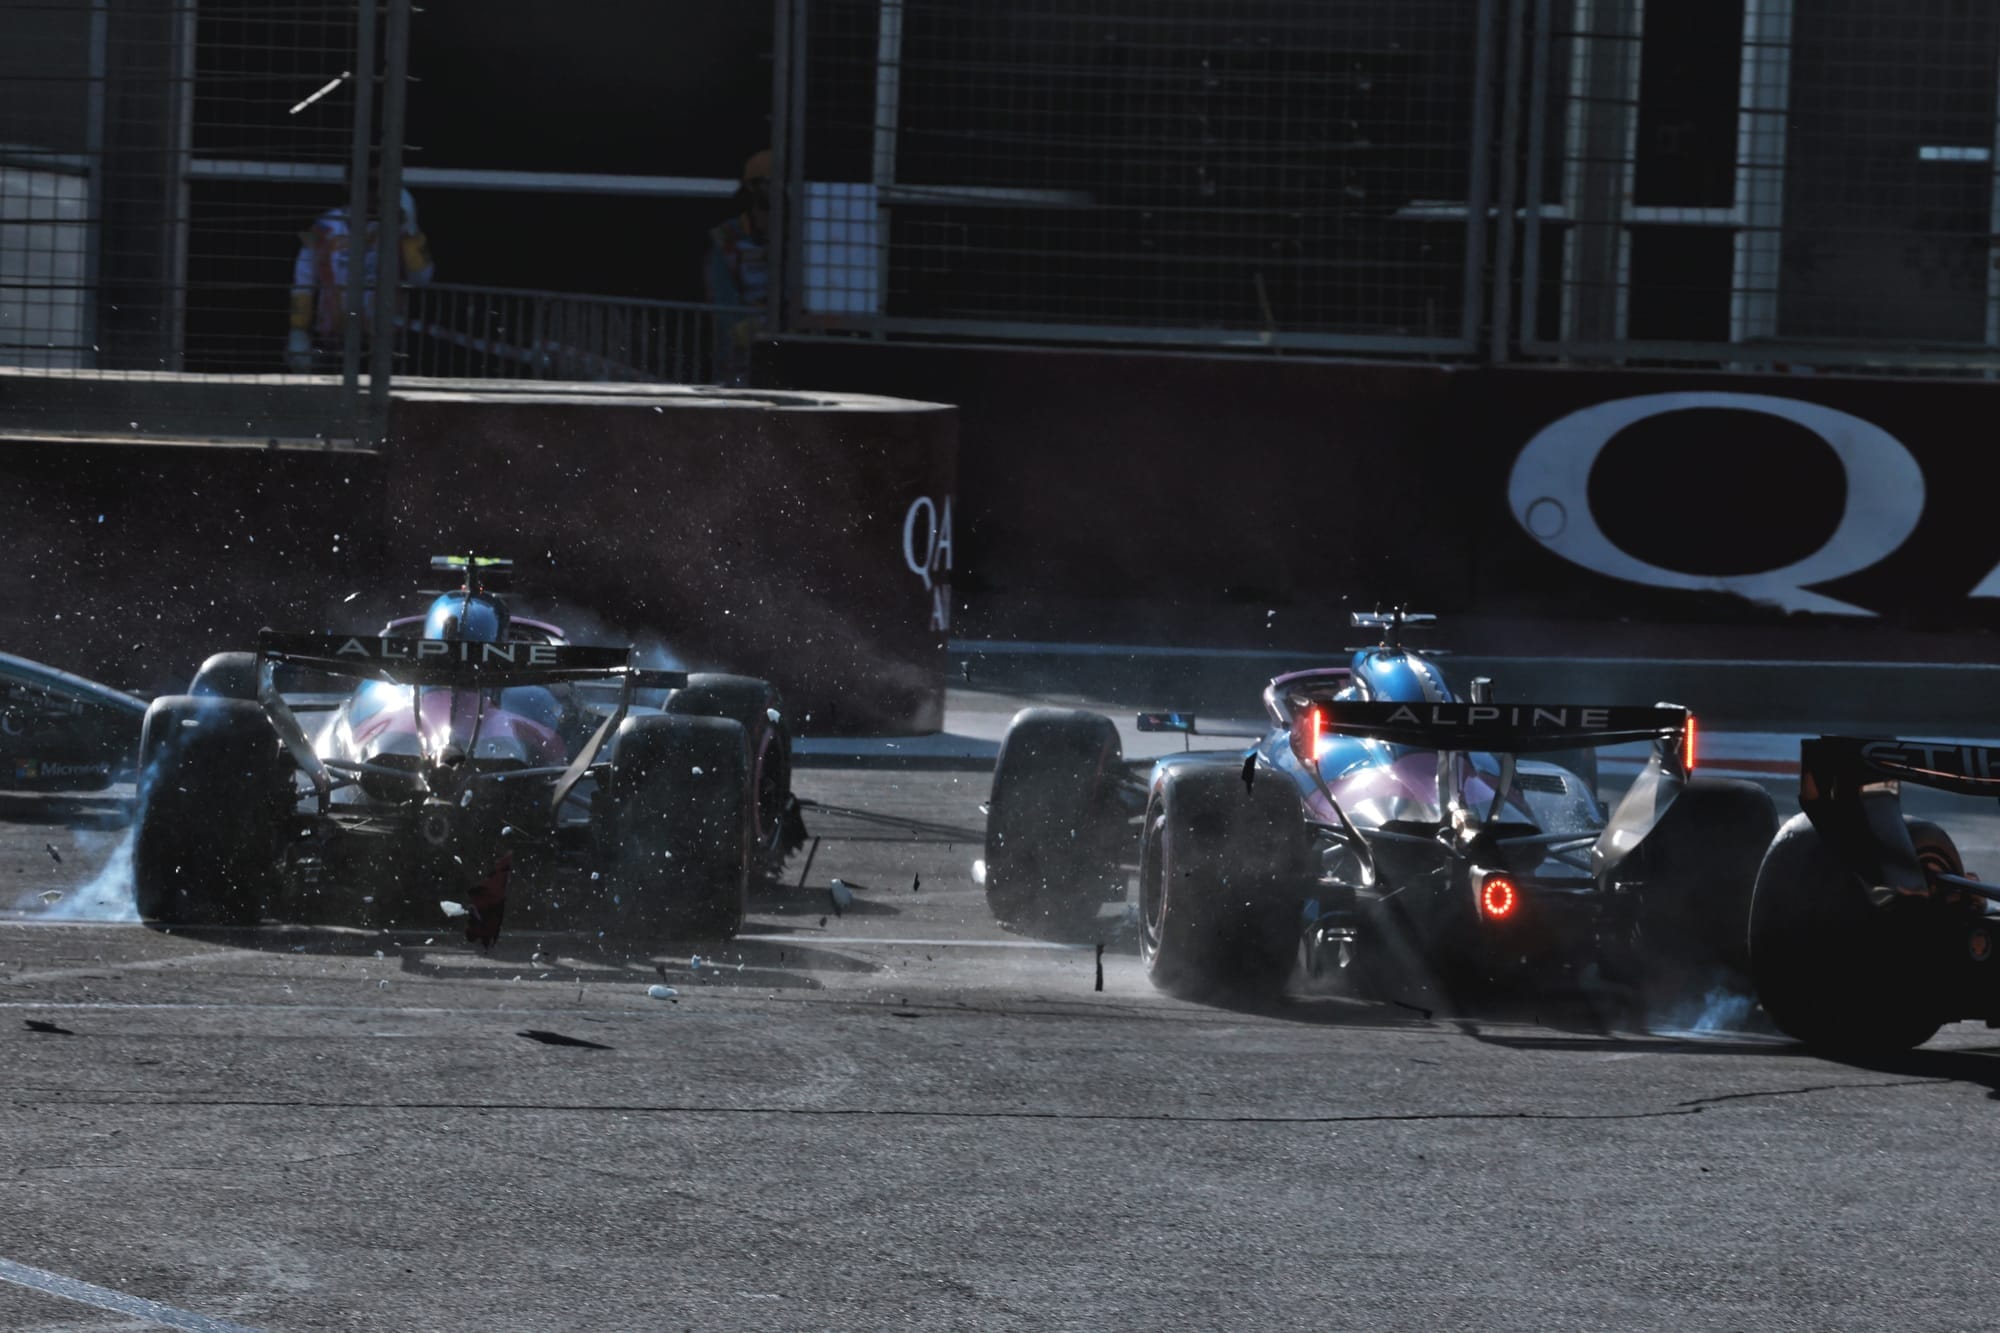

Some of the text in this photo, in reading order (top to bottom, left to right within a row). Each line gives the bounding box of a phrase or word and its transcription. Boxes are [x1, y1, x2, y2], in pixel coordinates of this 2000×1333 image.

[1507, 390, 2000, 617] Q
[336, 637, 558, 664] ALPINE
[1385, 704, 1609, 728] ALPINE
